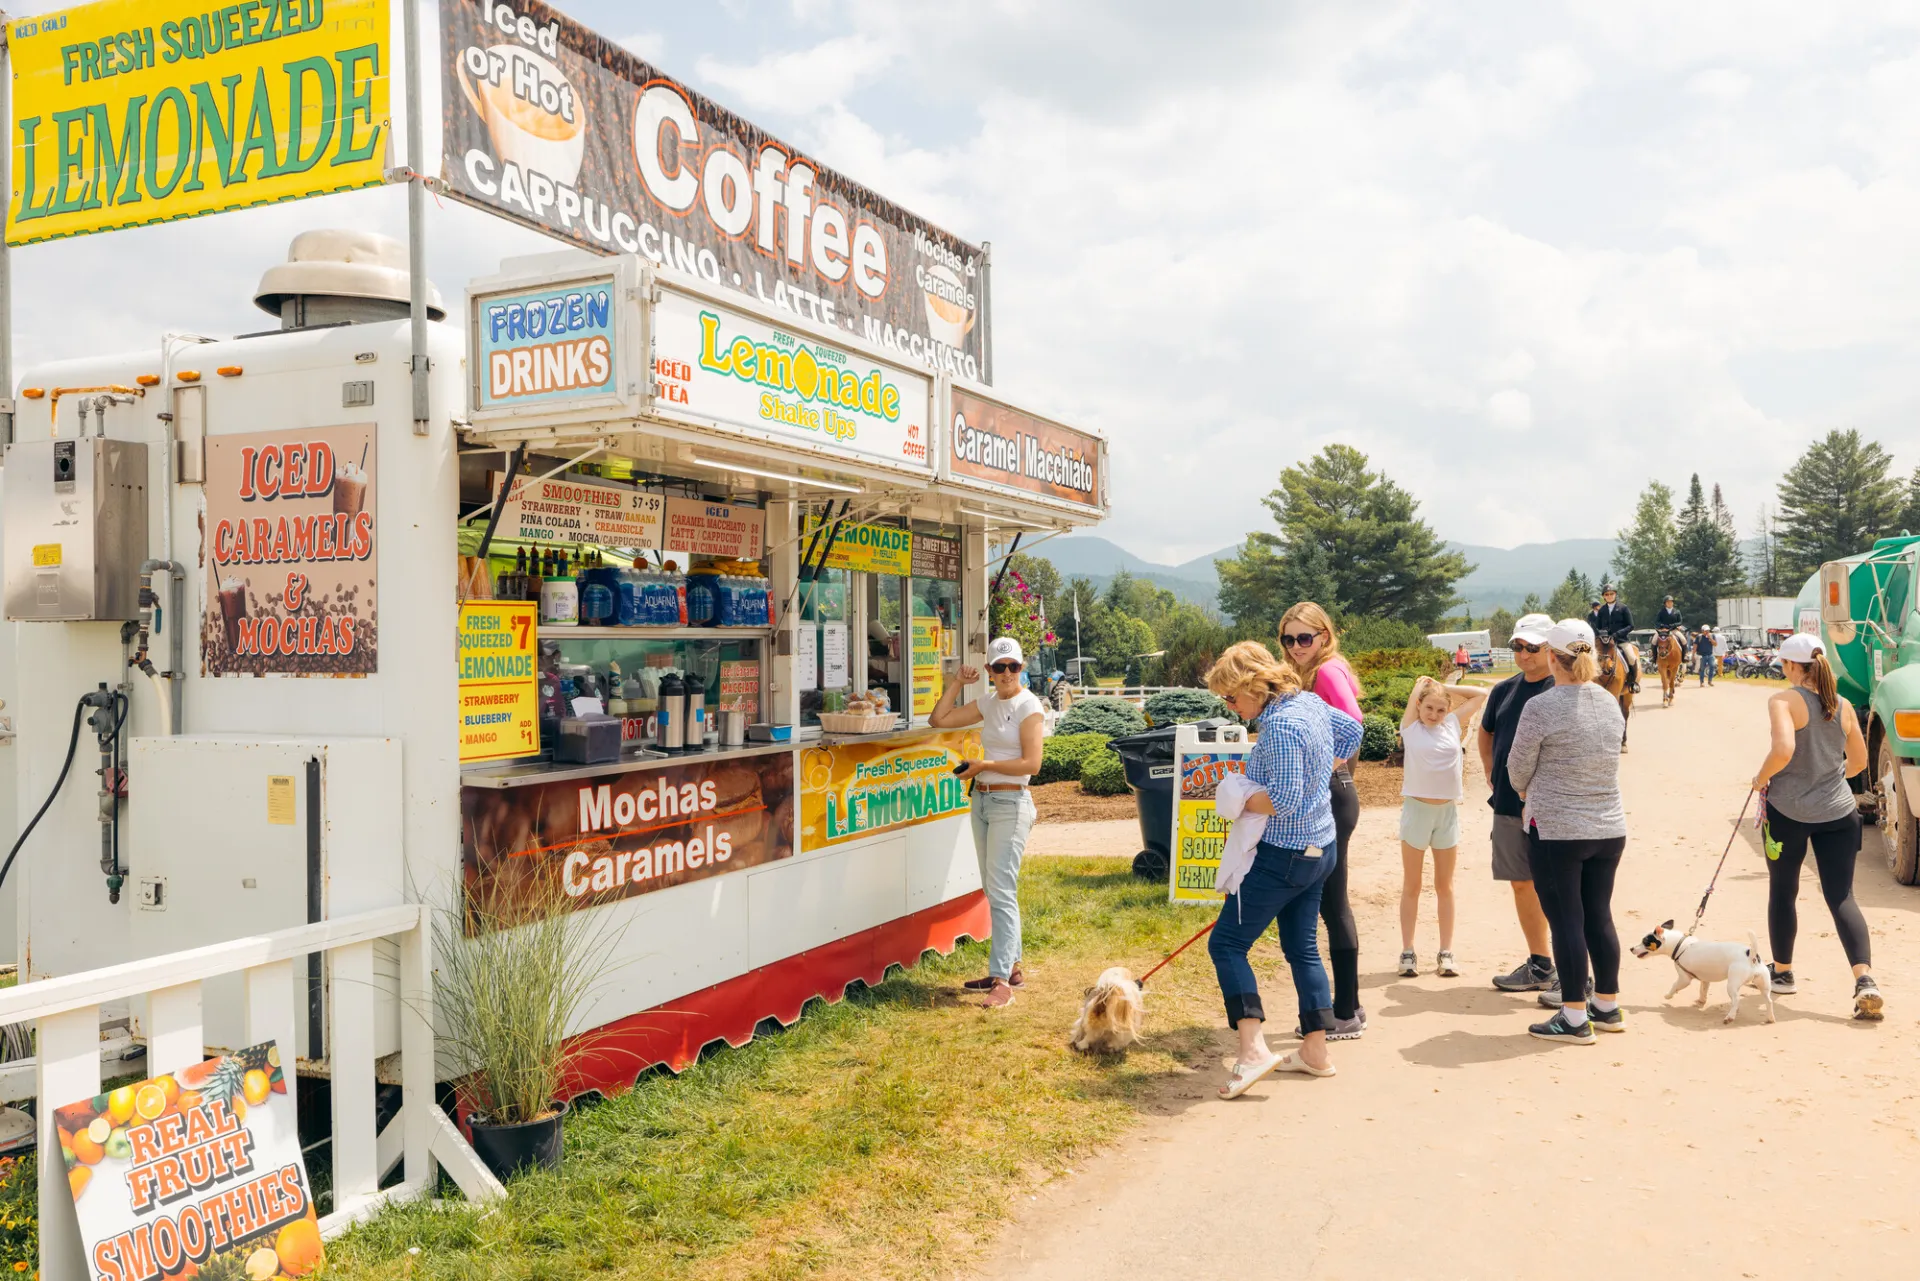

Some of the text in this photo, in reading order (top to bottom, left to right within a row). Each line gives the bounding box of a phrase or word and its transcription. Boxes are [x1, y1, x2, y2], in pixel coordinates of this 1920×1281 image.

[15, 15, 67, 39] ICED COLD
[484, 0, 559, 59] Iced
[61, 0, 324, 85] FRESH SQUEEZED
[465, 46, 575, 124] or Hot
[15, 43, 380, 223] LEMONADE
[632, 79, 888, 302] Coffee
[464, 148, 978, 382] CAPPUCCINO LATTE MACCHIATO
[914, 228, 976, 278] Mochas &
[915, 264, 976, 311] Caramels
[488, 291, 609, 343] FROZEN
[773, 330, 847, 364] FRESH SQUEEZED
[490, 337, 611, 398] DRINKS
[655, 358, 691, 382] ICED
[699, 310, 900, 423] Lemonade
[657, 380, 689, 405] TEA
[760, 392, 857, 442] Shake Ups
[911, 424, 925, 445] HOT
[904, 446, 932, 469] COFFEE
[953, 411, 1093, 494] Caramel Macchiato
[239, 441, 337, 502] ICED
[542, 483, 621, 508] SMOOTHIES
[521, 500, 657, 524] STRAWBERRY STRAW/BANANA
[521, 512, 644, 536] PIÑA COLADA CREAMSICLE
[671, 514, 705, 528] CARAMEL
[706, 518, 746, 532] MACCHIATO
[706, 506, 729, 518] ICED
[214, 510, 373, 566] CARAMELS
[519, 527, 652, 549] MANGO MOCHA/CAPPUCCINO
[670, 526, 695, 539] LATTE
[670, 540, 689, 551] CHAI
[922, 537, 939, 552] SWEET
[284, 571, 309, 612] &
[236, 615, 356, 656] MOCHAS
[458, 633, 513, 651] SQUEEZED
[466, 615, 531, 650] FRESH $7
[458, 655, 532, 679] LEMONADE
[735, 665, 759, 677] Carame
[912, 651, 939, 665] EMONADE
[464, 693, 520, 707] STRAWBERRY
[465, 712, 512, 726] BLUEBERRY
[519, 720, 532, 728] ADD
[465, 730, 532, 745] MANGO $1
[856, 751, 948, 780] Fresh Squeezed
[1183, 755, 1211, 771] ICED
[578, 773, 717, 833] Mochas
[826, 772, 969, 839] LEMONADE
[1195, 809, 1234, 833] FRE
[562, 825, 732, 898] Caramels
[1182, 837, 1224, 860] SQUE
[125, 1098, 238, 1169] REAL
[125, 1127, 253, 1213] FRUIT
[94, 1163, 307, 1281] SMOOTHIES
